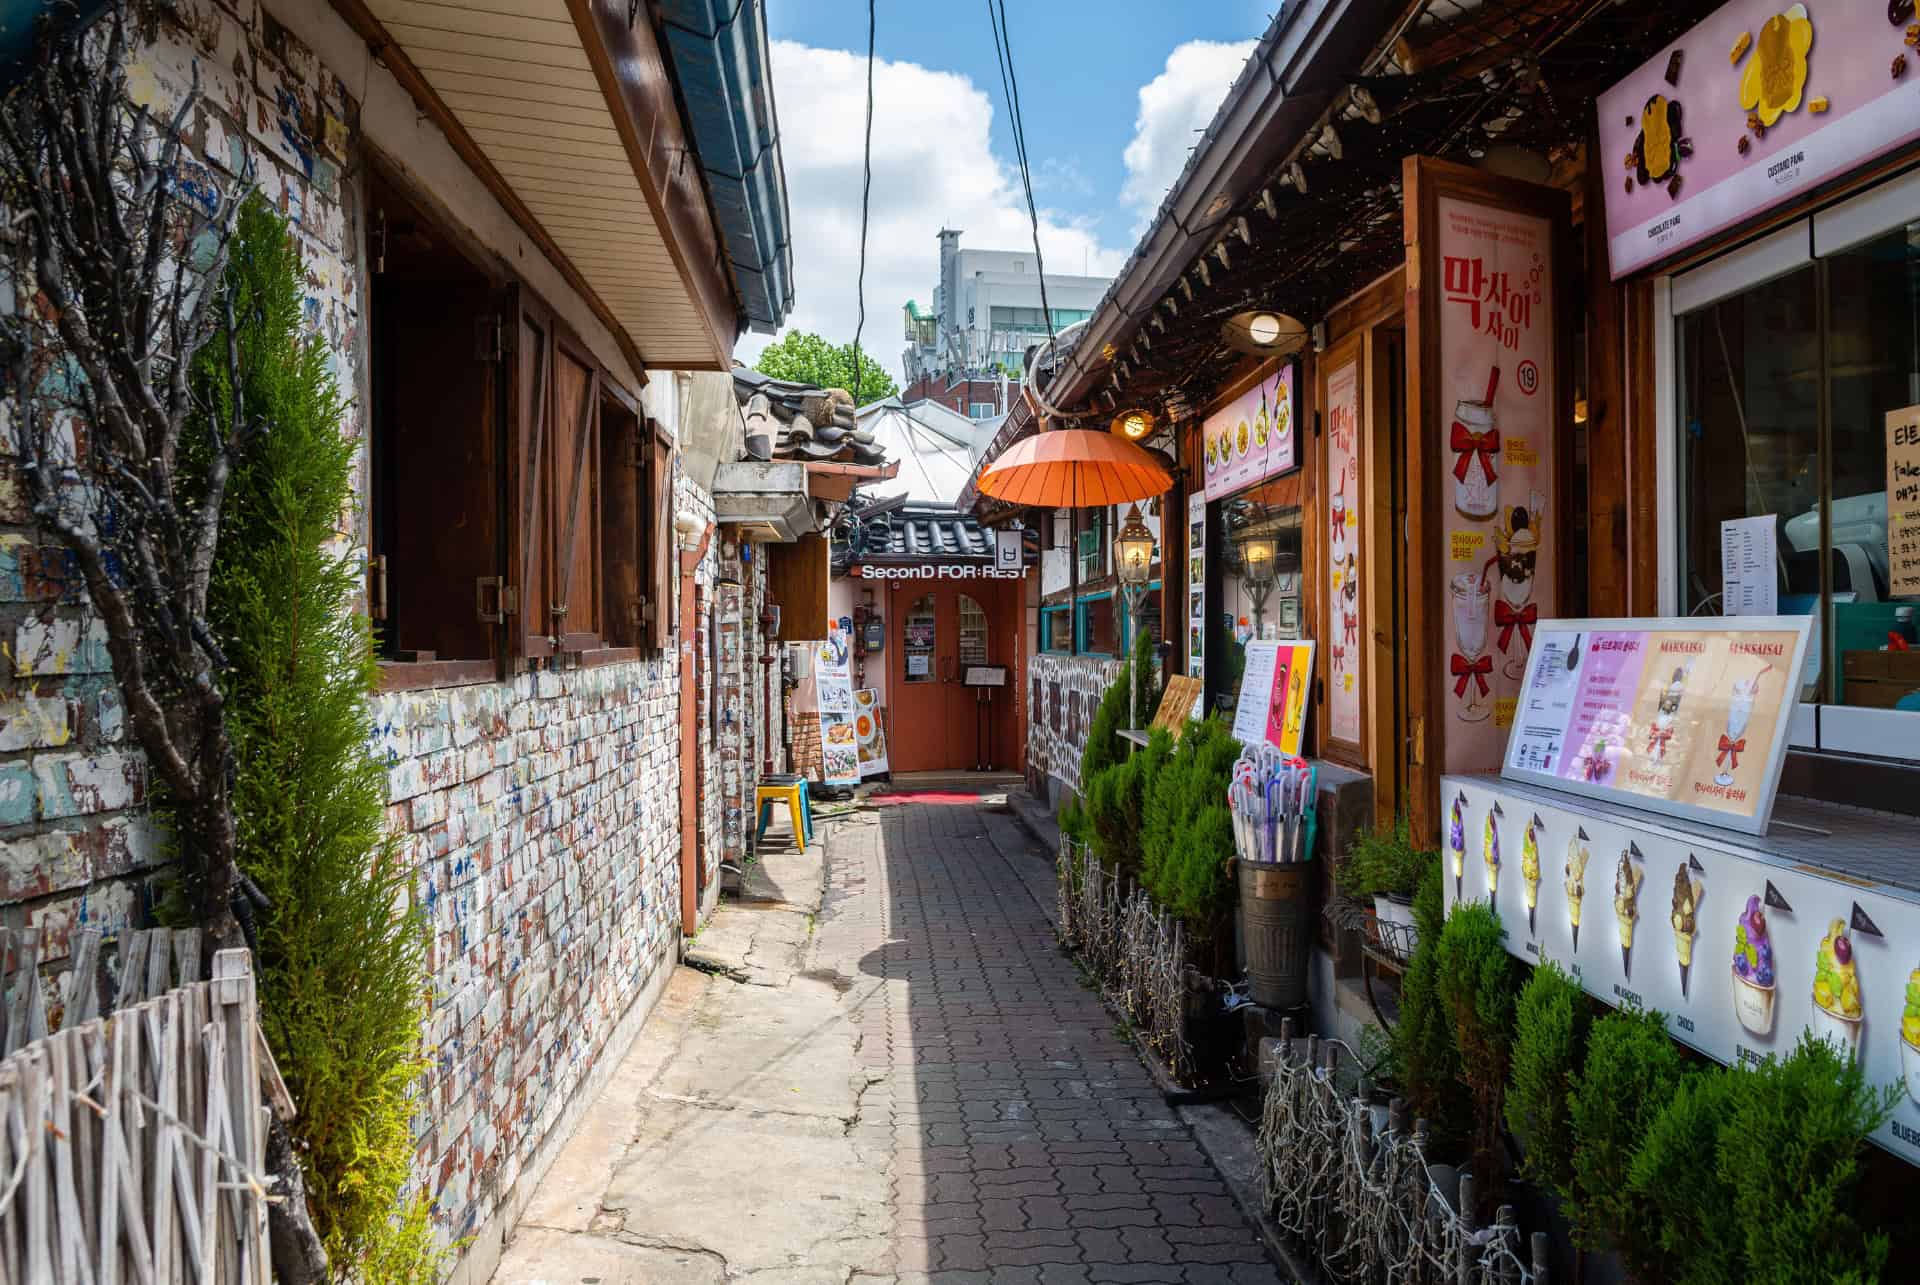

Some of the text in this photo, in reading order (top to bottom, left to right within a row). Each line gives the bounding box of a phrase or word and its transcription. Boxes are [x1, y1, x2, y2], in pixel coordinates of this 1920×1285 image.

[1520, 366, 1535, 389] 19
[861, 565, 935, 579] SeconD
[1677, 1014, 1695, 1033] CHOCO
